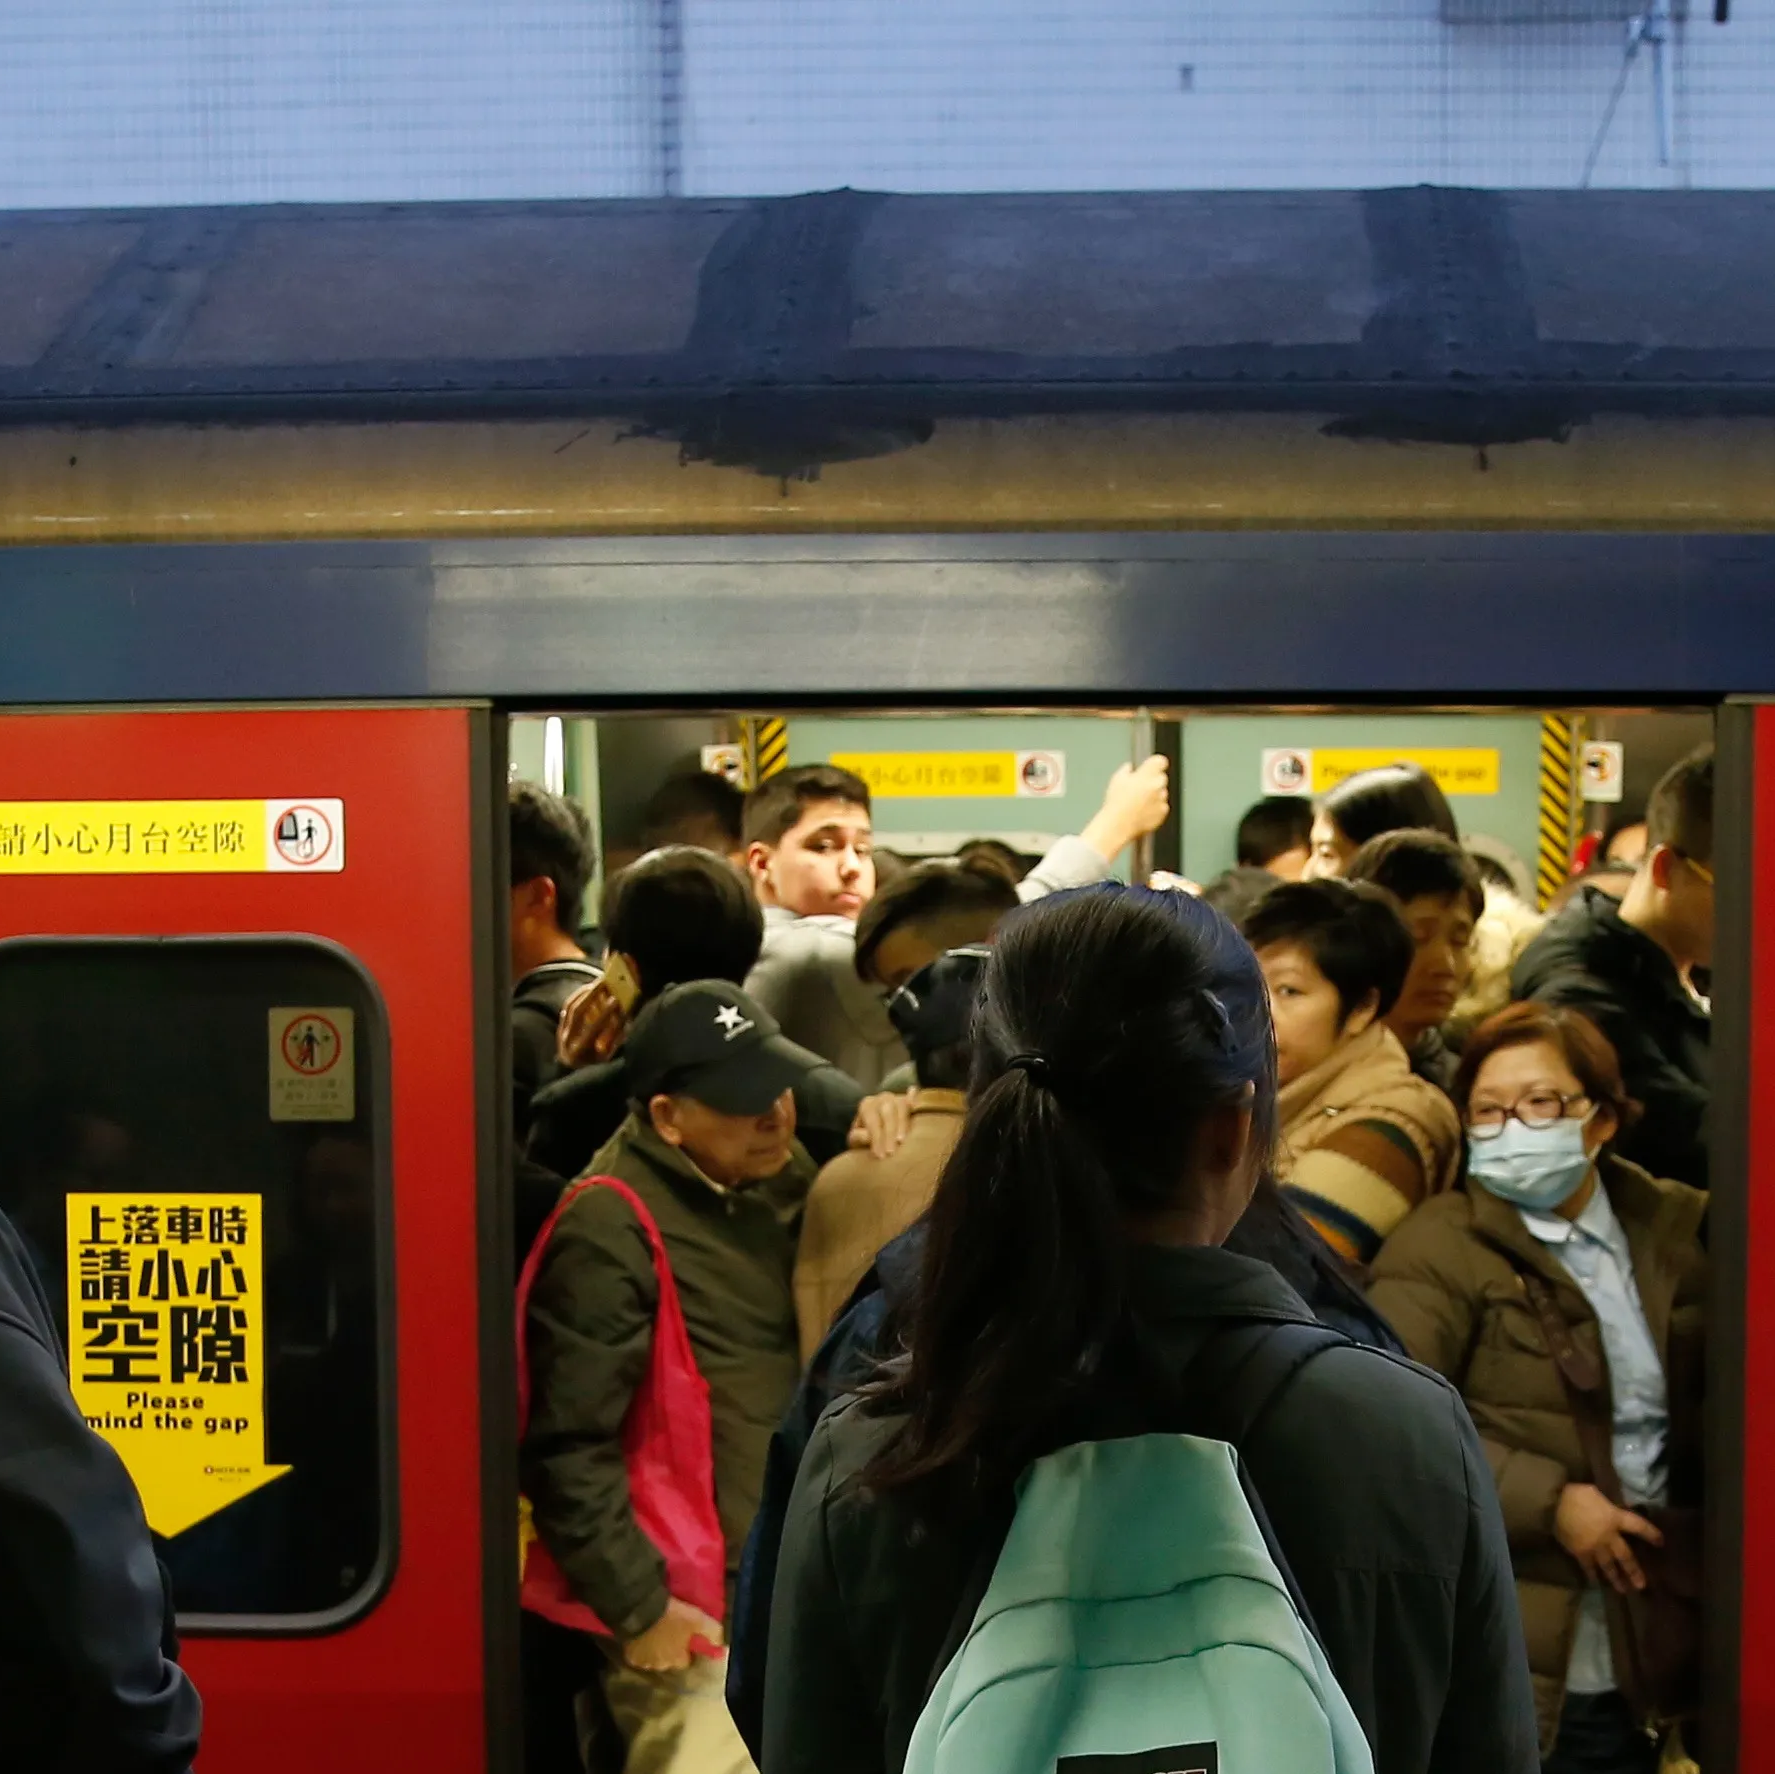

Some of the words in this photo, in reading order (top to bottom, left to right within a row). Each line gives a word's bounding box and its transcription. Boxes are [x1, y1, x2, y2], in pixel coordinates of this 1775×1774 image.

[79, 1205, 248, 1246] 上落車時
[80, 1248, 248, 1302] 請小心
[82, 1304, 249, 1384] 空隙
[126, 1391, 205, 1410] Please
[87, 1412, 143, 1430] mind
[154, 1412, 193, 1431] the
[204, 1417, 249, 1435] gap
